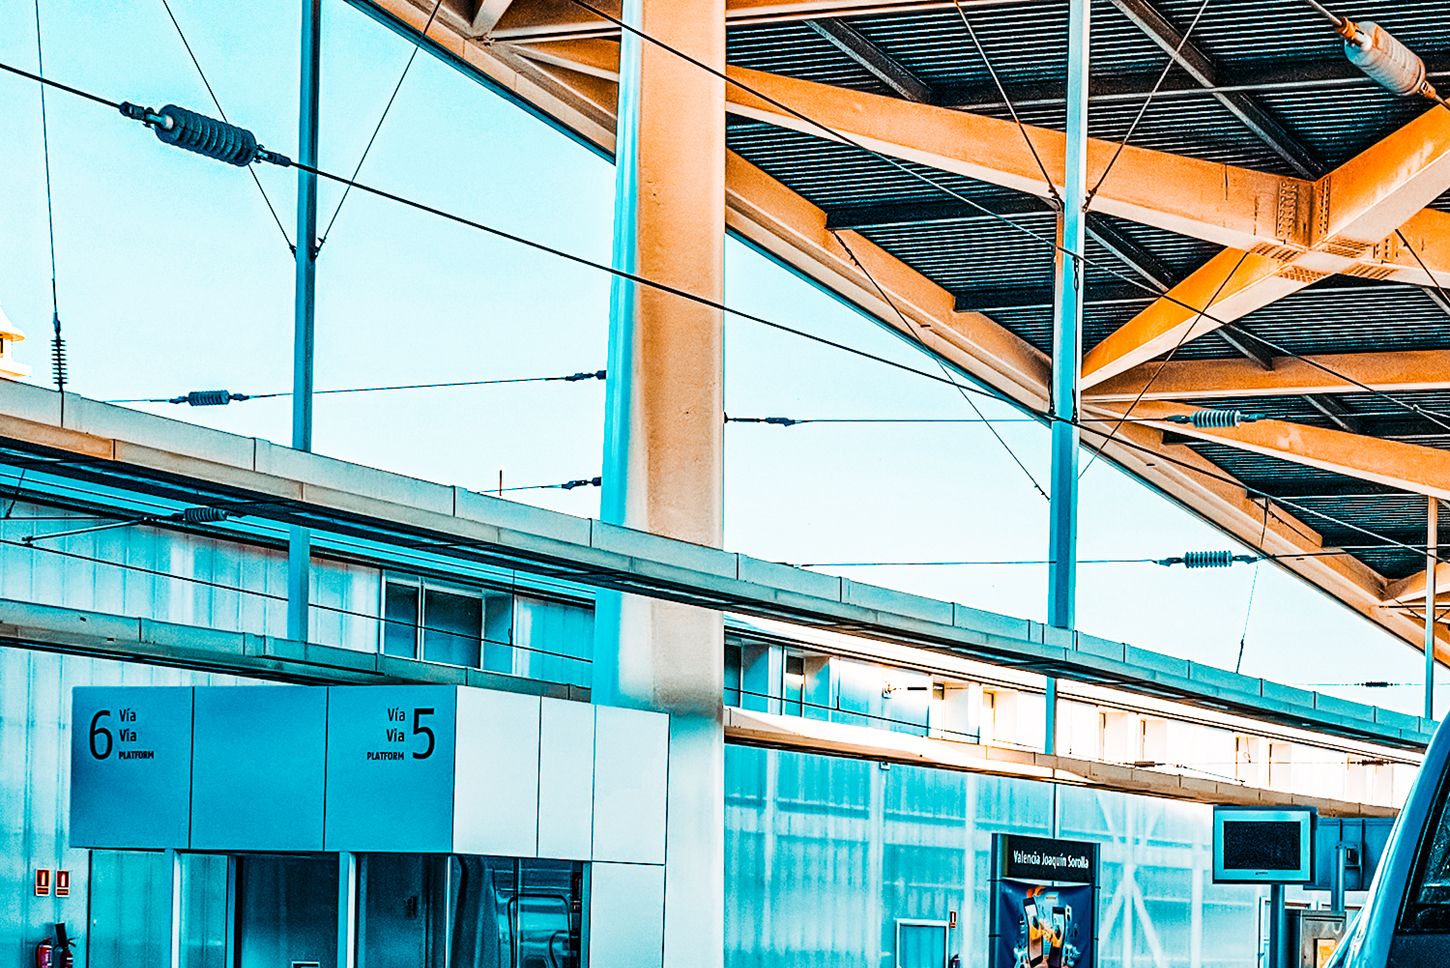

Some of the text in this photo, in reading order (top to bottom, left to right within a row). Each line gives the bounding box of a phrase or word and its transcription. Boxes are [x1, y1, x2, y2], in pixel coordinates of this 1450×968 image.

[119, 708, 136, 722] Vía
[387, 707, 405, 721] Vía
[90, 710, 113, 760] 6
[386, 728, 405, 742] Via
[412, 708, 435, 759] 5
[118, 751, 154, 759] PLATFORM
[367, 751, 405, 760] PLATFORM
[1013, 850, 1089, 869] Valencia Joaquín Sorolla
